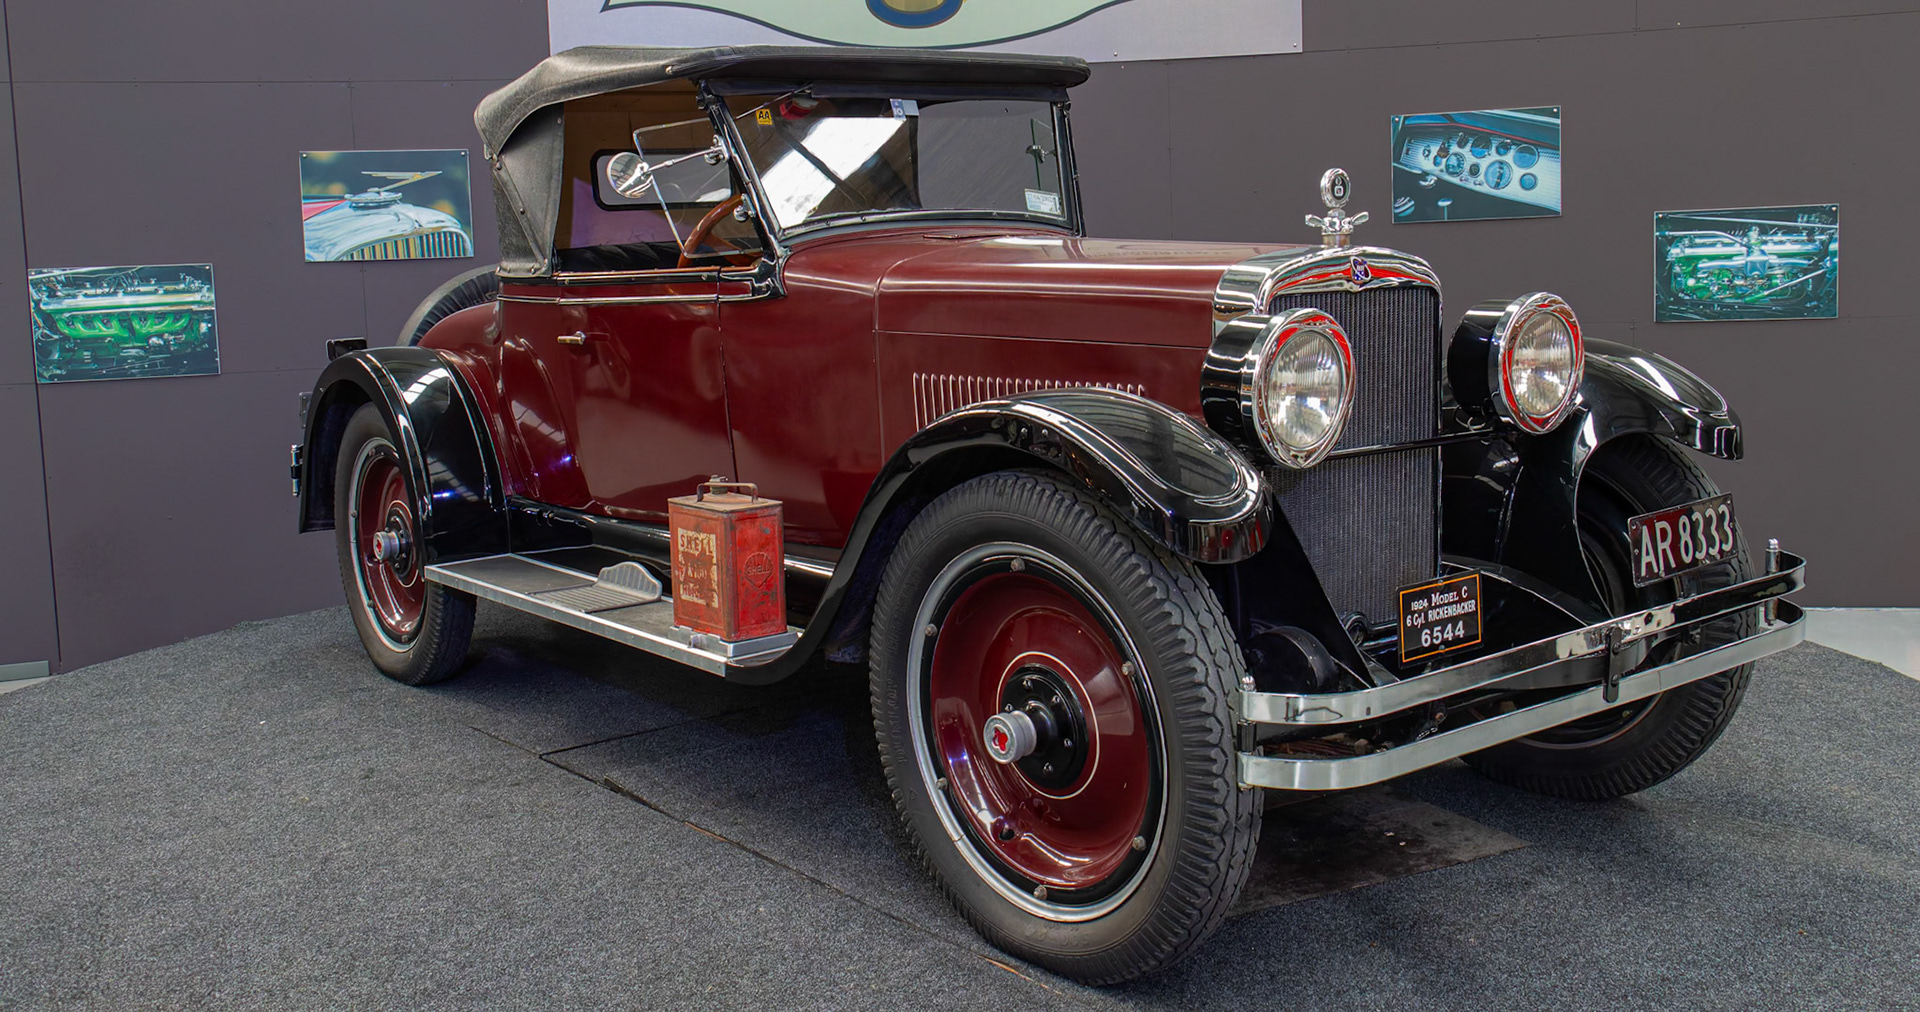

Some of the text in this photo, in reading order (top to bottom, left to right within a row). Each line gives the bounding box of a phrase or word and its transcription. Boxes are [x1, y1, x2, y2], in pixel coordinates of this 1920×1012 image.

[759, 111, 770, 120] AA
[1641, 503, 1733, 577] AR 8333
[747, 565, 770, 575] SHELL
[1411, 586, 1468, 611] 1924 MODEL C
[1406, 614, 1412, 627] 6
[1428, 599, 1476, 623] RICKENBACKER
[1421, 620, 1465, 648] 6544
